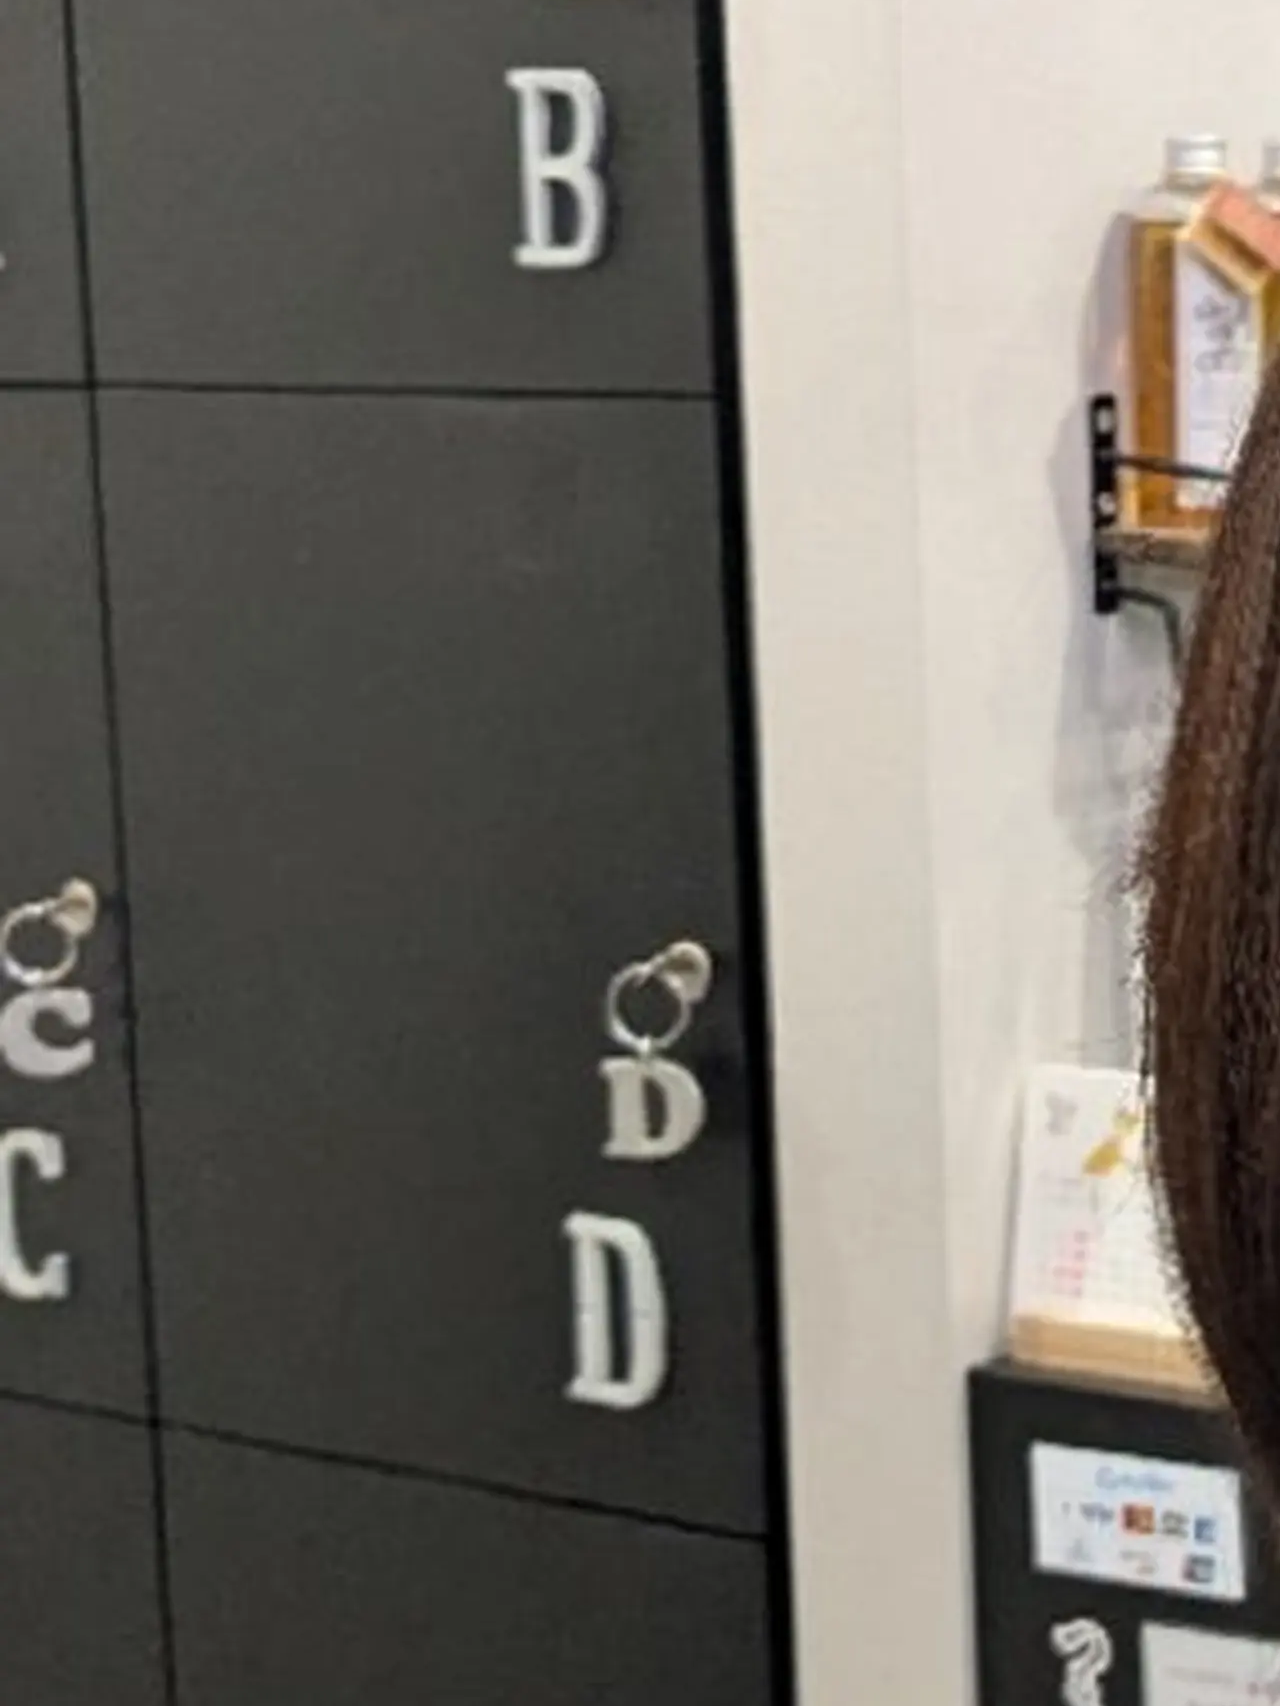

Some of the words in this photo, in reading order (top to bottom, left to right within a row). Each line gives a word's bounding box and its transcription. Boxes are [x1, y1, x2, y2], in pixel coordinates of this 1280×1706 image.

[505, 67, 606, 268] B
[599, 1055, 707, 1161] D
[562, 1209, 669, 1411] D
